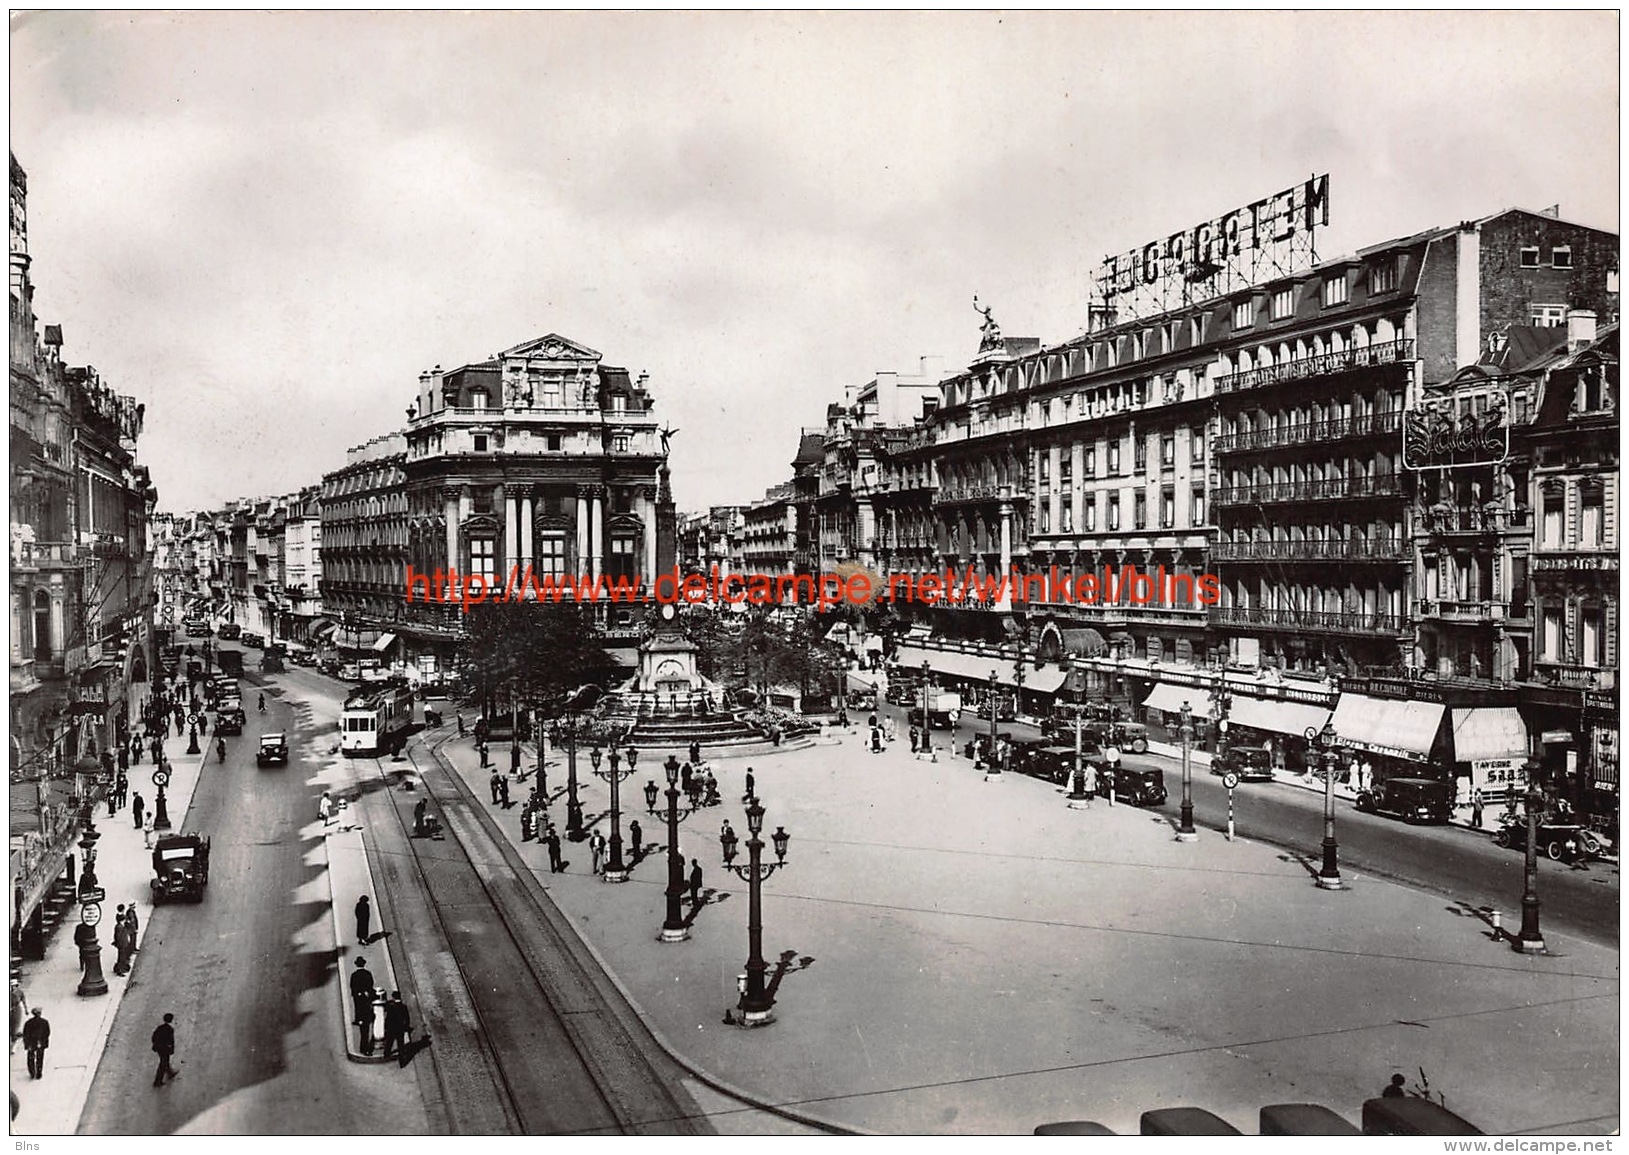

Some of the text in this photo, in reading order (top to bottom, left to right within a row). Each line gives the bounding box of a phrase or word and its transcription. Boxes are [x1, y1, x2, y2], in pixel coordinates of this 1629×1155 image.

[808, 505, 819, 593] ATLANTA
[163, 574, 174, 624] WALON
[1475, 760, 1512, 769] TAVERNE
